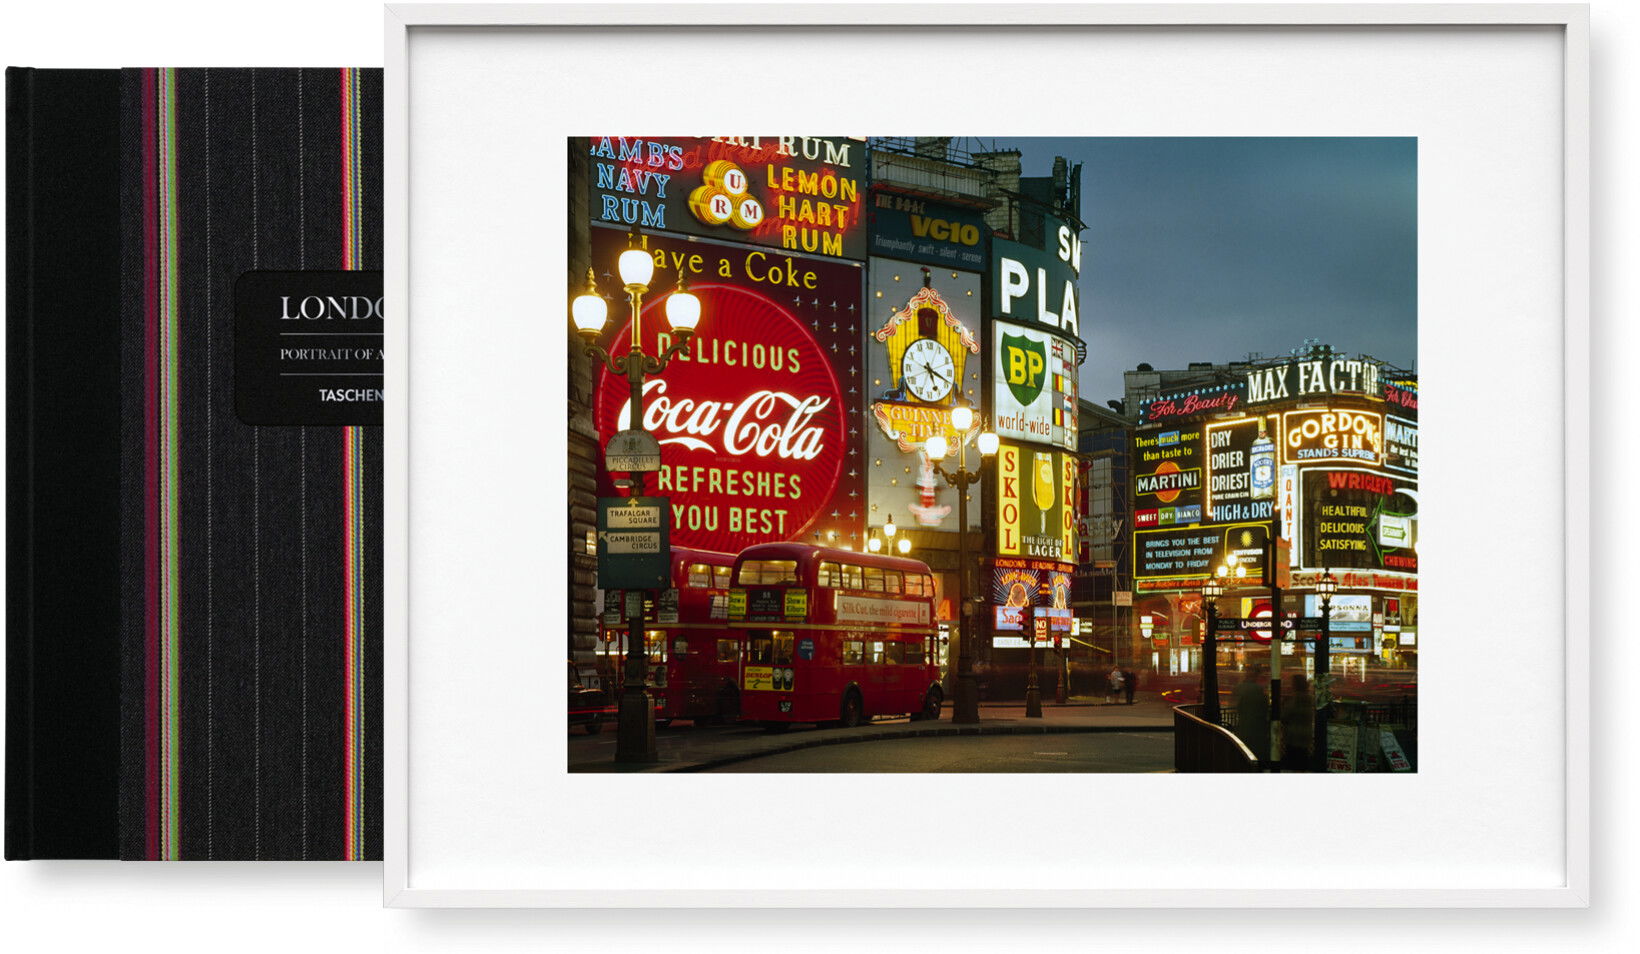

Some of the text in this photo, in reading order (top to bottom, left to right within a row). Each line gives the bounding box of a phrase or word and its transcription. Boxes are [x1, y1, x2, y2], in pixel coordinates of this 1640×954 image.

[590, 136, 684, 171] AMB'S
[776, 136, 851, 167] RUM
[597, 162, 671, 199] NAVY
[728, 173, 742, 190] U
[767, 163, 857, 203] LEMON
[601, 194, 666, 229] RUM
[715, 200, 728, 215] R
[744, 204, 758, 220] M
[778, 195, 849, 229] HART
[909, 213, 980, 246] VC10
[782, 224, 843, 257] RUM
[718, 258, 732, 278] a
[745, 251, 818, 290] Coke
[1001, 257, 1079, 337] PLA
[280, 348, 352, 360] PORTRAIT
[354, 348, 374, 360] OF
[1007, 345, 1044, 388] BP
[1246, 359, 1379, 403] MAX FACTOR
[319, 388, 385, 402] TASCHEN
[1149, 391, 1239, 421] For Beauty
[617, 379, 832, 461] Coca-Cola
[890, 407, 953, 426] GUINNE
[998, 411, 1050, 436] world-wide
[1136, 431, 1200, 448] There's much more
[1211, 430, 1232, 449] DRY
[1288, 412, 1381, 453] GORDON'S
[1323, 433, 1363, 449] GIN
[1143, 446, 1193, 461] than taste to
[1211, 450, 1244, 471] DRIER
[1297, 448, 1339, 459] STANDS
[657, 464, 802, 500] REFRESHES
[1137, 472, 1198, 492] MARTINI
[1211, 472, 1250, 492] DRIEST
[1327, 472, 1394, 496] WRIGLEY'S
[1003, 450, 1019, 551] SKOL
[1063, 461, 1073, 555] SKOL
[672, 504, 788, 535] YOU BEST
[1137, 513, 1157, 523] SWEET
[1160, 511, 1174, 520] DRY
[1212, 501, 1274, 521] HIGH & DRY
[1285, 479, 1293, 551] QANTA
[1322, 505, 1368, 517] HEALTHFUL
[1320, 522, 1365, 533] DELICIOUS
[1028, 544, 1062, 558] LAGER
[1146, 536, 1220, 548] BRINGS YOU THE BEST
[1320, 539, 1367, 551] SATISFYING
[1146, 547, 1213, 559] IN TELEVISION FROM
[1146, 559, 1210, 570] MONDAY TO FRIDAY
[869, 604, 879, 615] the
[880, 605, 893, 617] mild
[1036, 620, 1046, 629] NO
[1241, 620, 1293, 629] UNDERGRND
